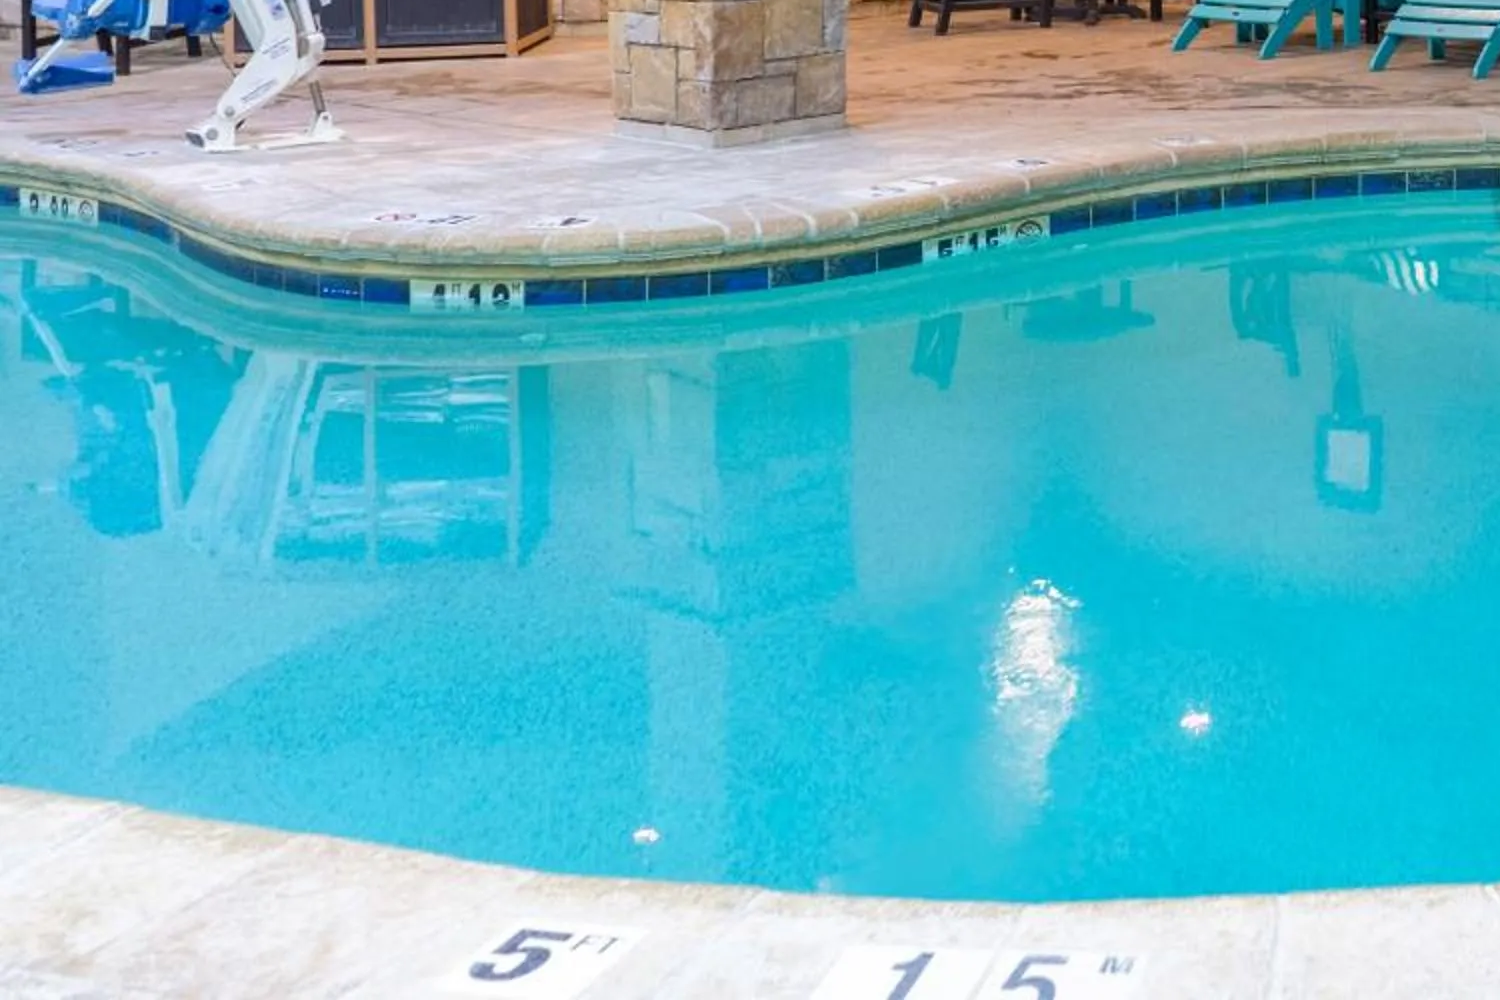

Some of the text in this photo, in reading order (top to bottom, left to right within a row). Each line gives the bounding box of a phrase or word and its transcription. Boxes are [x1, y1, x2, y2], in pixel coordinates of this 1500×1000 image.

[468, 928, 620, 981] 5 FT
[1099, 955, 1137, 974] M
